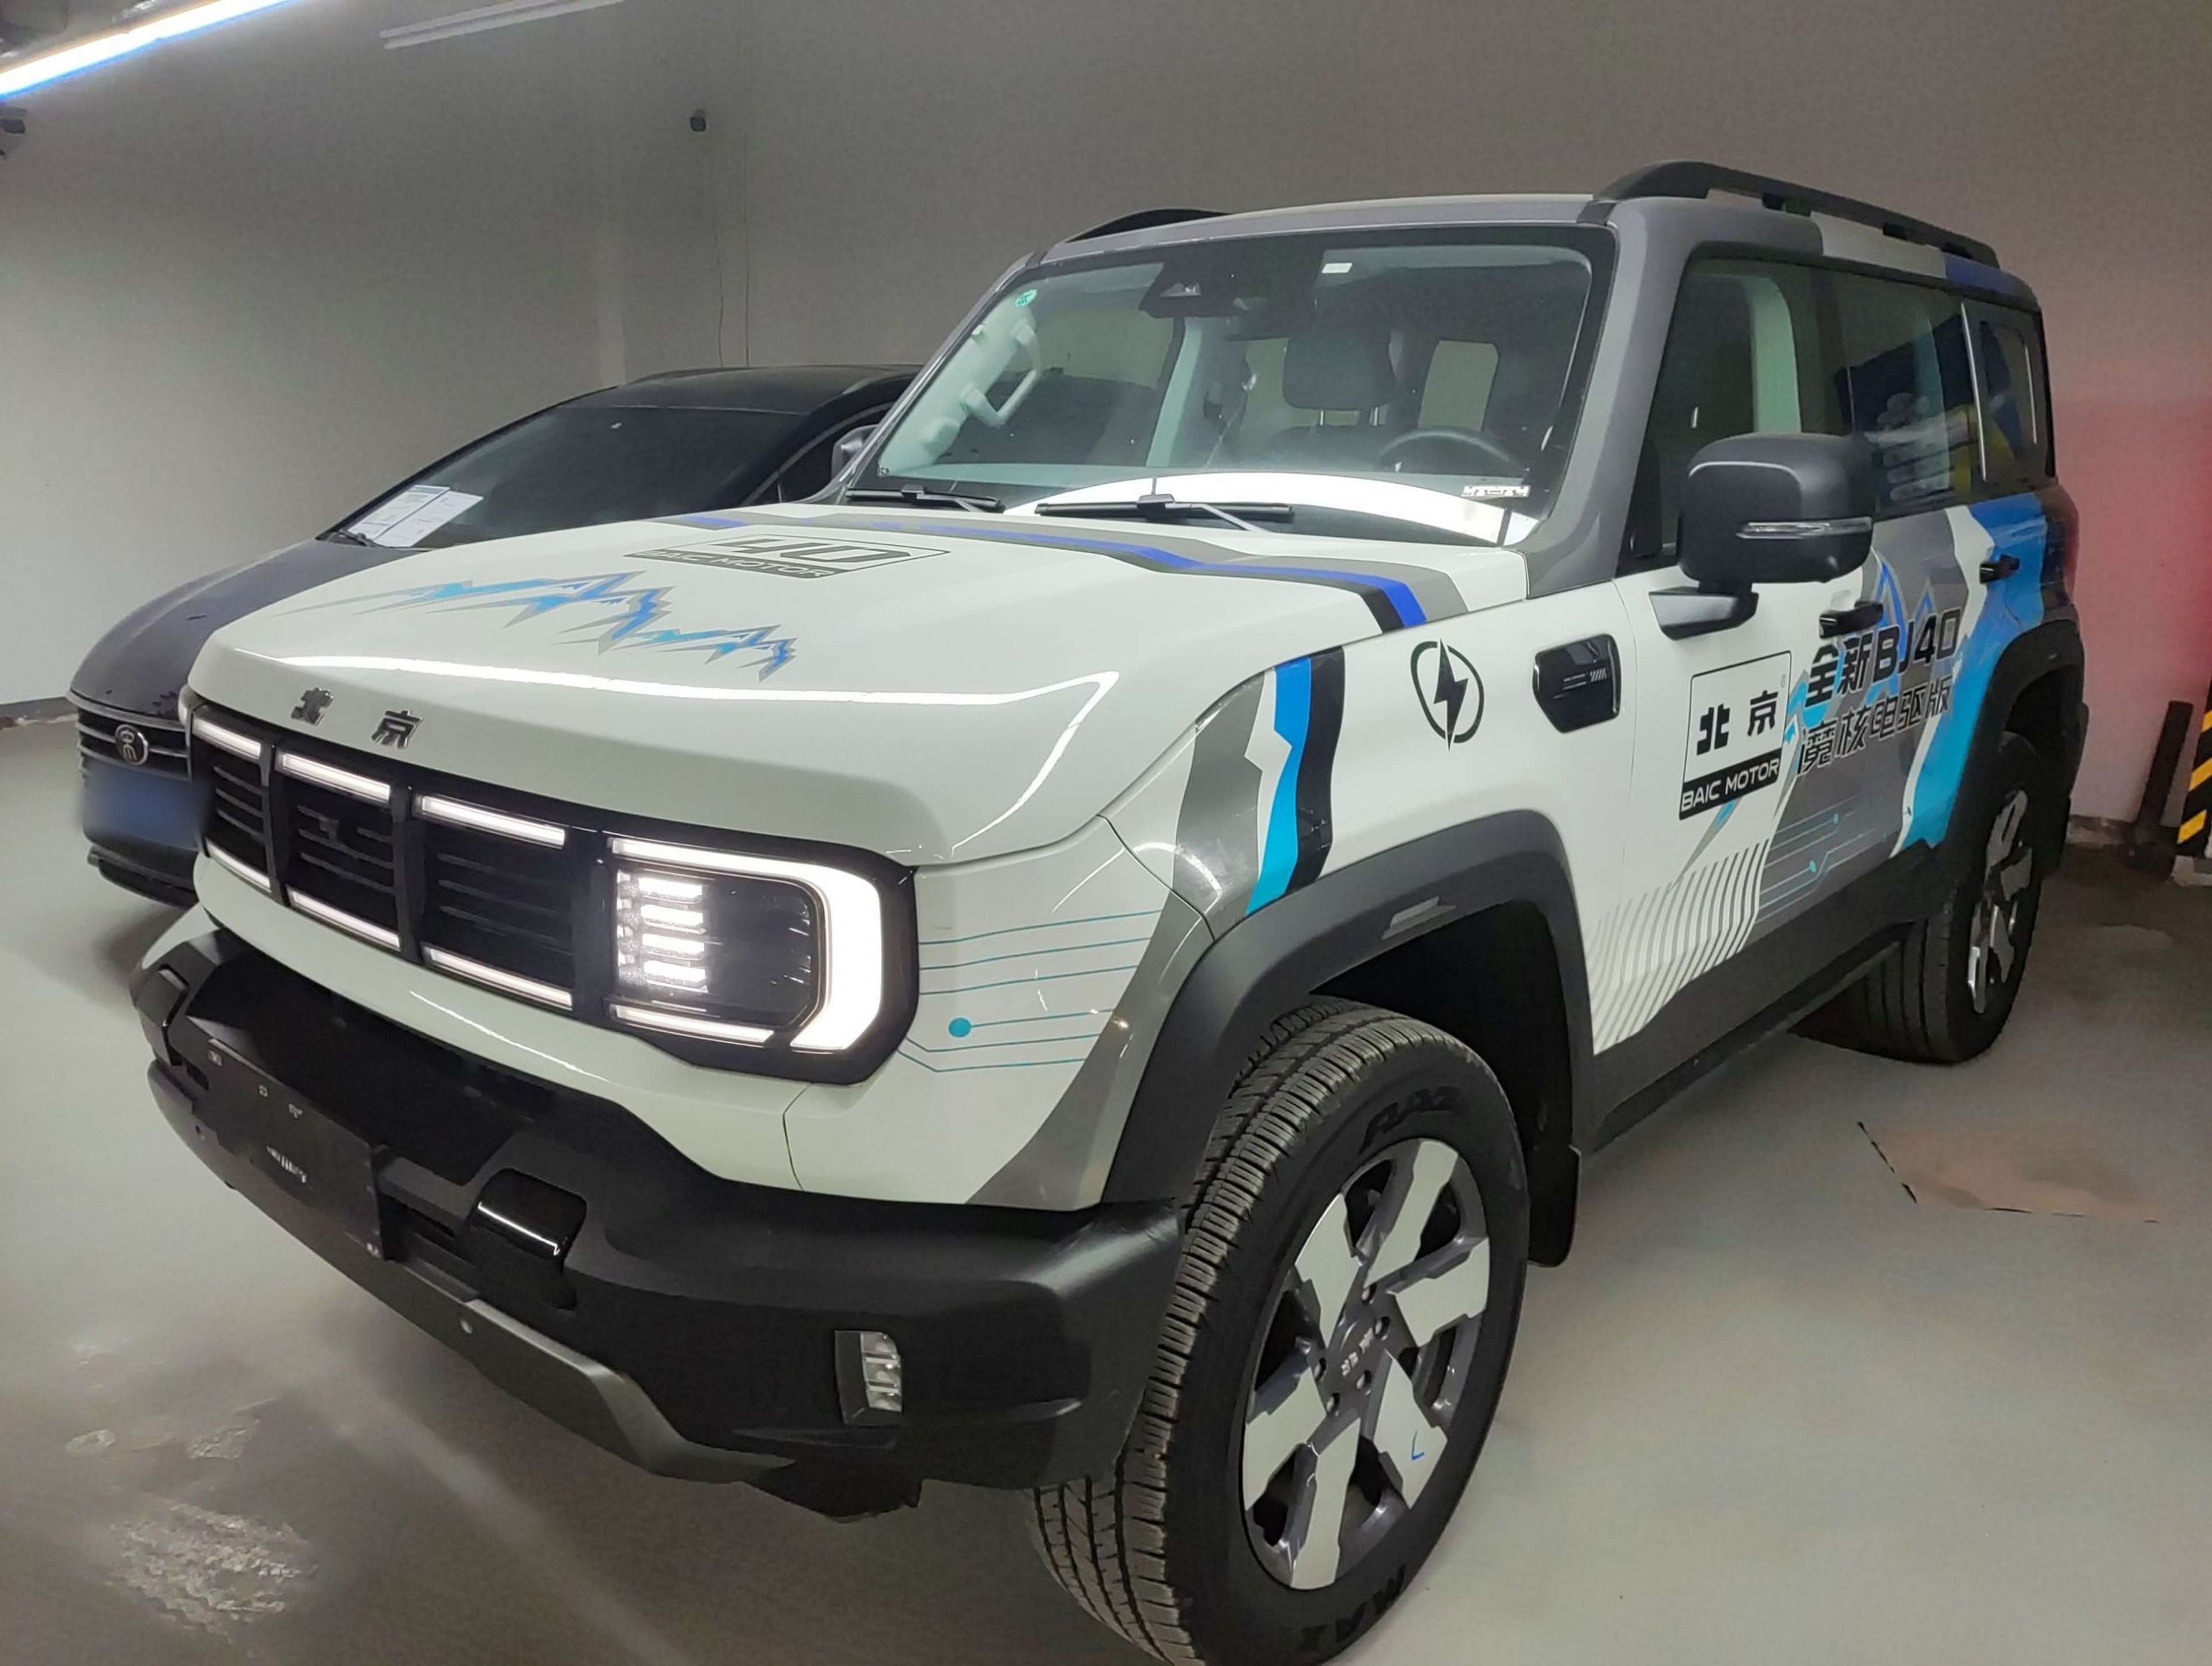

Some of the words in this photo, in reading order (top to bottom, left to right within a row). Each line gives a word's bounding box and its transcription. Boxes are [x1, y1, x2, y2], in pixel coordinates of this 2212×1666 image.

[710, 558, 835, 577] MOTOR
[1696, 690, 1778, 756] 北京
[1681, 779, 1721, 812] BAIC
[1725, 758, 1779, 795] MOTOR
